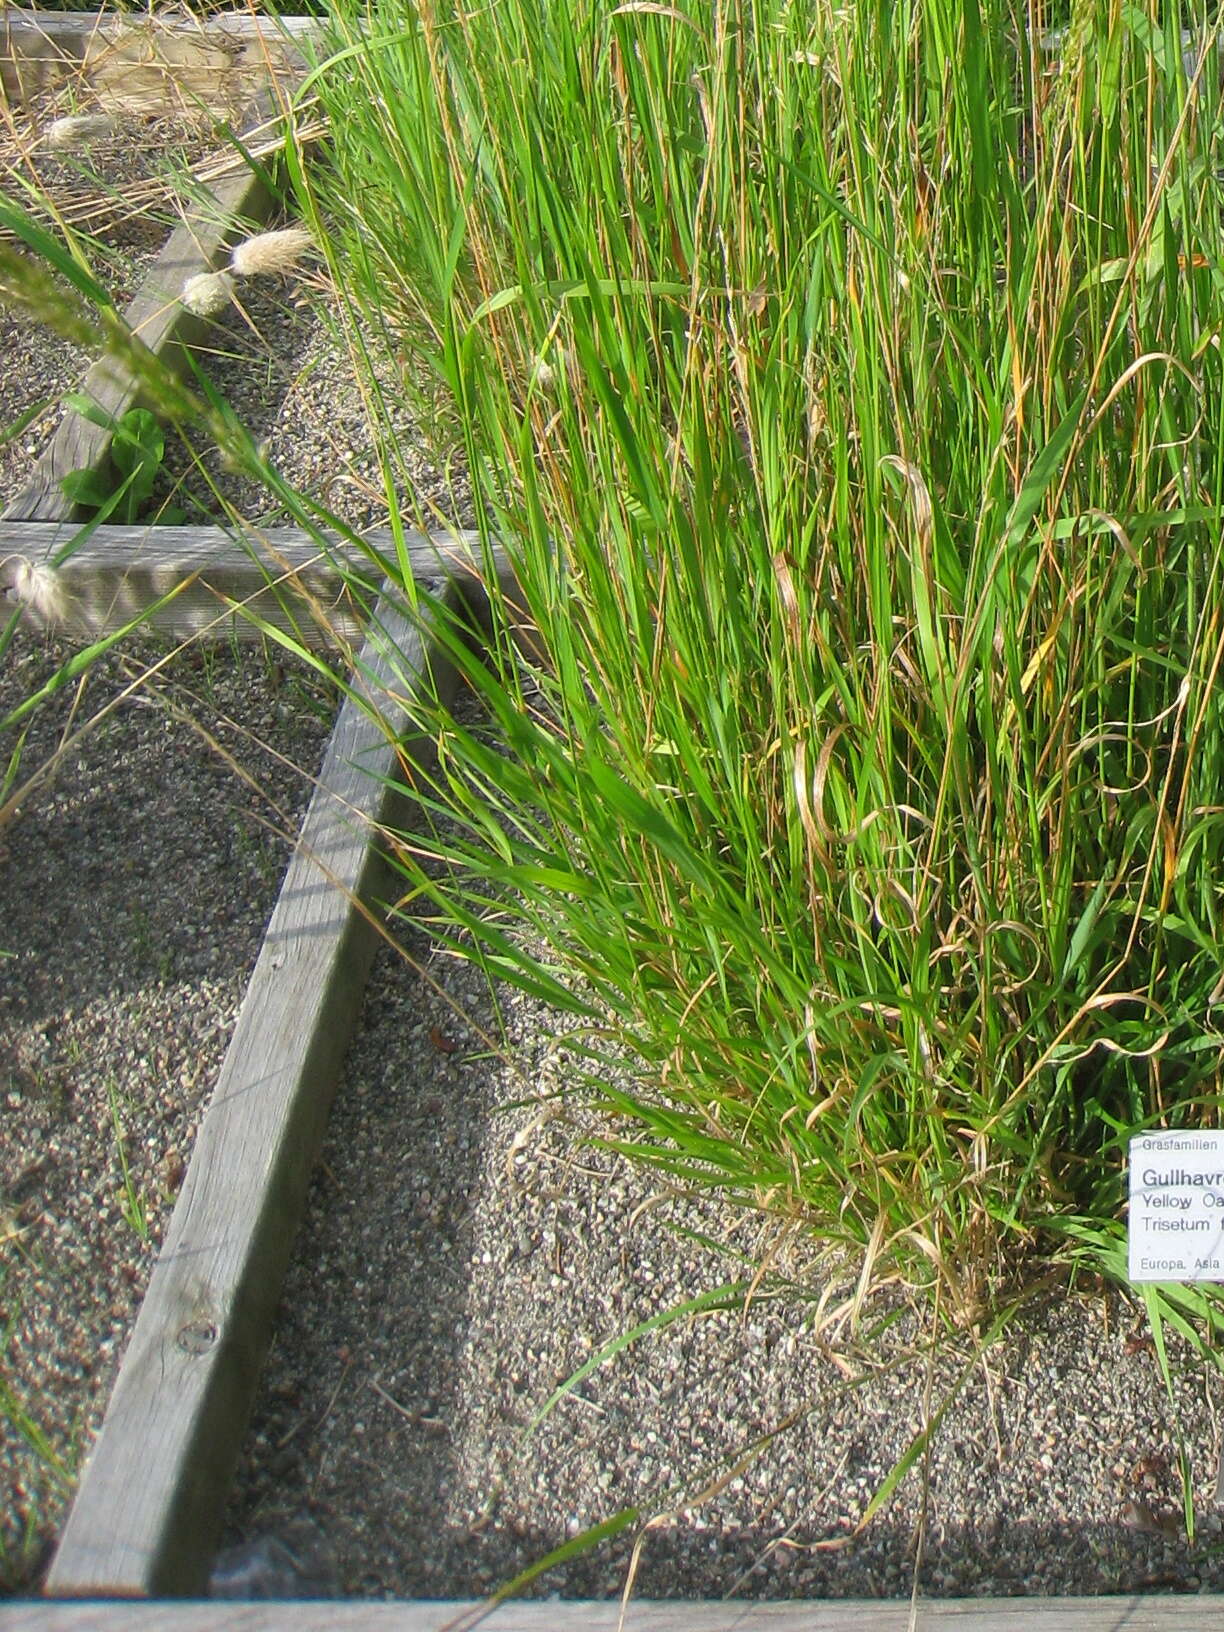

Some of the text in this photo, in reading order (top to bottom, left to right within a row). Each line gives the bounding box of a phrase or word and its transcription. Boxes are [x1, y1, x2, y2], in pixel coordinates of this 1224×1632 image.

[1142, 1138, 1218, 1151] Grasfamilien
[1142, 1194, 1193, 1209] Yellow
[1142, 1217, 1210, 1231] Trisetum
[1194, 1257, 1220, 1269] Asia
